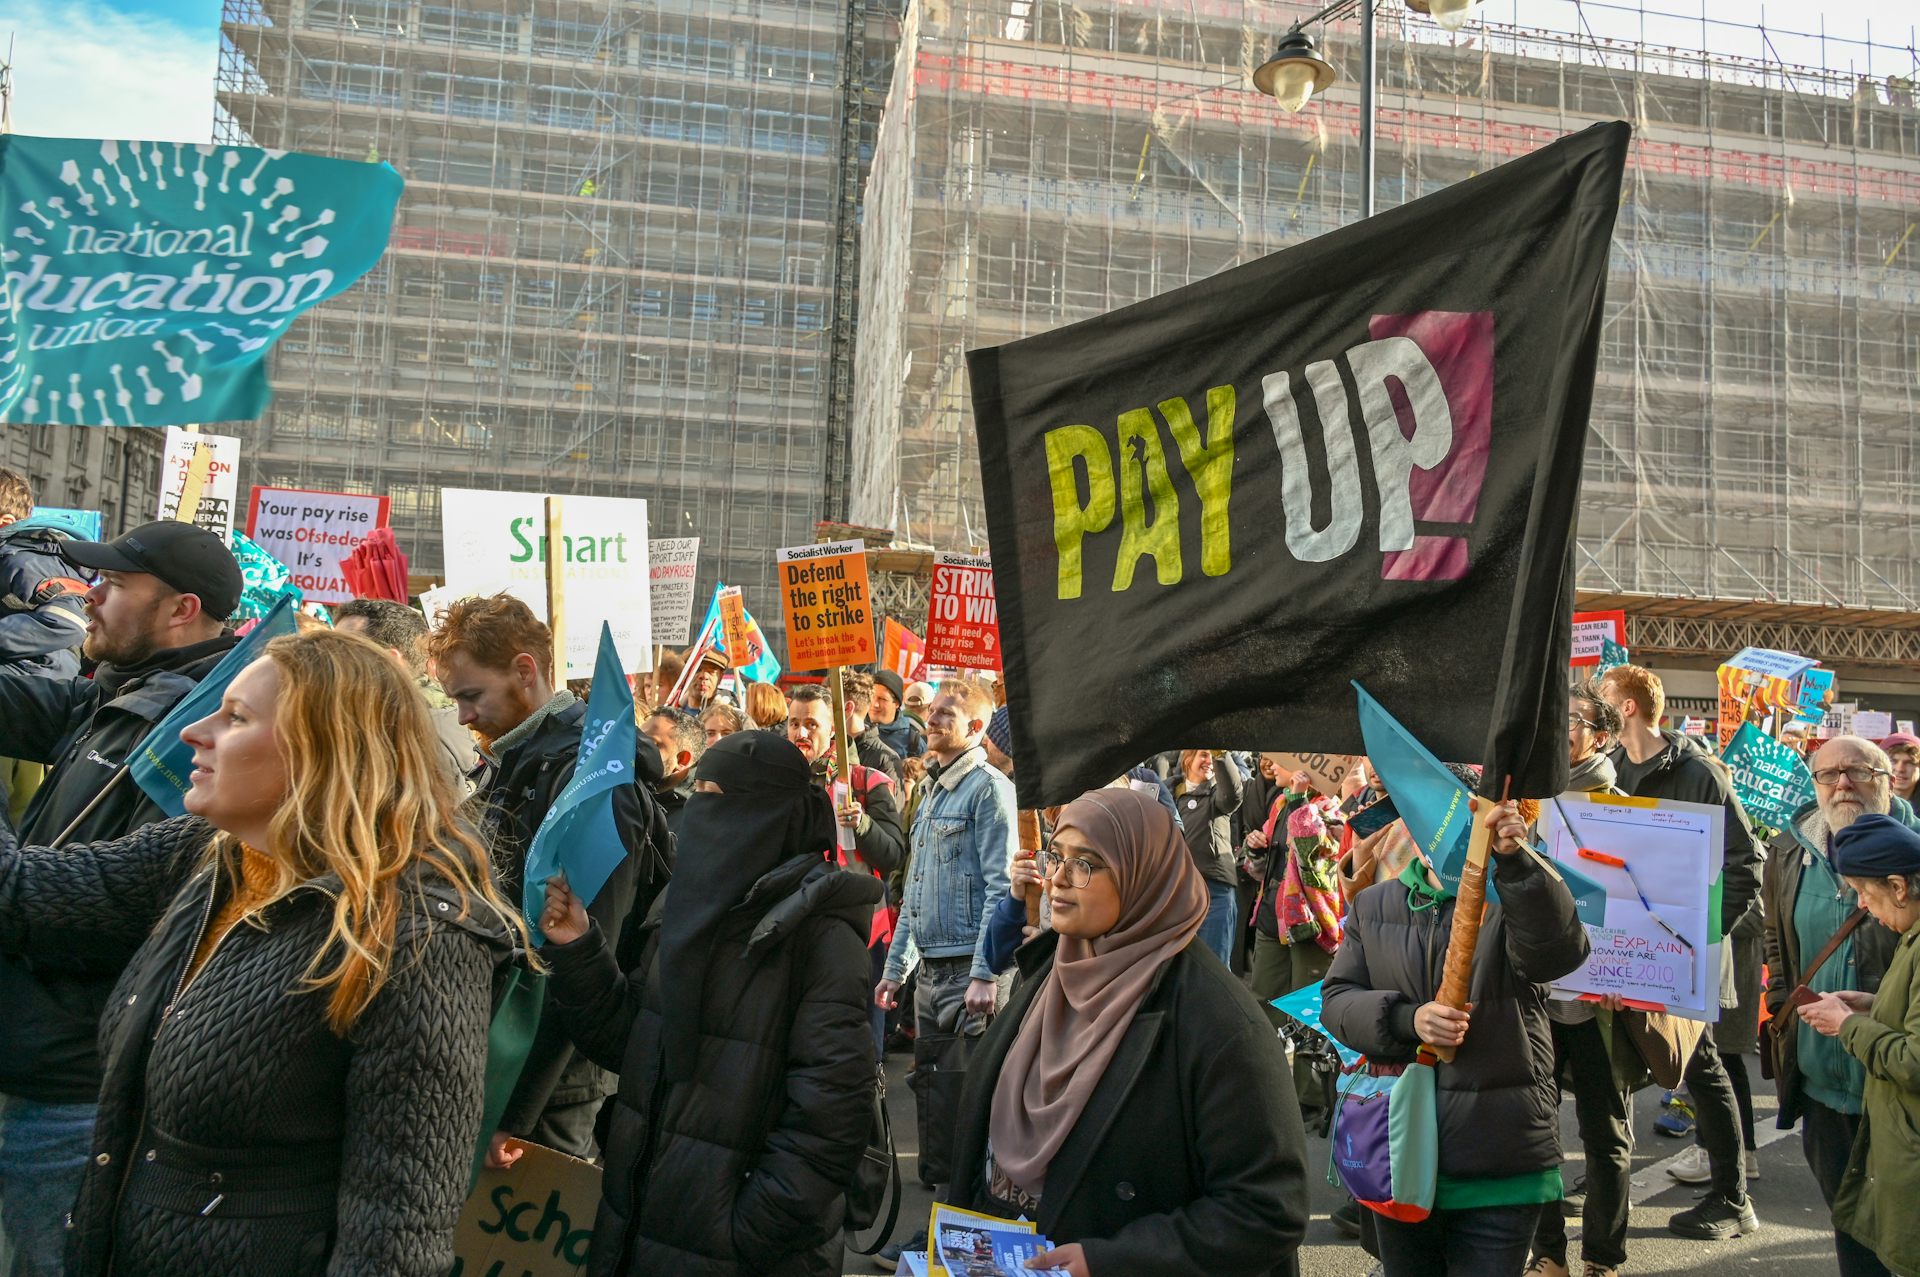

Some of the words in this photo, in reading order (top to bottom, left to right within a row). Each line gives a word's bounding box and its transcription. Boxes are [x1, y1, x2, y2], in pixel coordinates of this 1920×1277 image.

[62, 211, 255, 257] national
[28, 311, 167, 351] union
[1044, 384, 1236, 600] PAY
[1261, 310, 1494, 581] UP!
[197, 500, 215, 511] OR
[216, 501, 228, 512] A
[260, 500, 297, 516] Your
[302, 507, 335, 523] pay
[338, 506, 368, 522] rise
[194, 514, 227, 525] NERAL
[260, 528, 293, 540] was
[648, 541, 655, 552] E
[656, 540, 676, 553] NEED
[676, 539, 693, 551] OUR
[787, 546, 823, 560] Socialist
[823, 544, 853, 555] Worker
[297, 552, 322, 567] It's
[648, 553, 674, 565] PPORT
[673, 551, 695, 562] STAFF
[943, 555, 975, 567] Socialist
[975, 558, 992, 568] Wor
[662, 565, 675, 578] PAY
[673, 564, 695, 578] RISES
[787, 560, 845, 585] Defend
[935, 567, 995, 598] STRIK
[790, 588, 817, 608] the
[822, 582, 862, 608] right
[934, 593, 959, 621] TO
[793, 612, 811, 631] to
[816, 605, 864, 628] strike
[934, 623, 946, 634] We
[949, 625, 959, 636] all
[962, 627, 982, 638] need
[1572, 624, 1580, 632] OU
[1581, 623, 1592, 631] CAN
[795, 636, 815, 648] Let's
[817, 633, 839, 646] break
[842, 632, 854, 642] the
[933, 637, 938, 645] a
[941, 637, 956, 649] pay
[958, 637, 975, 648] rise
[1582, 634, 1600, 642] THANK
[796, 647, 836, 660] anti-union
[838, 645, 856, 655] laws
[931, 649, 957, 661] Strike
[958, 654, 994, 666] together
[1575, 646, 1600, 655] TEACHER
[1721, 699, 1741, 710] WITH
[1823, 719, 1841, 728] UT!
[1293, 753, 1345, 783] OOLS
[1753, 758, 1810, 788] national
[1728, 763, 1812, 807] educatio
[1603, 806, 1622, 815] Figure
[1748, 793, 1784, 812] union
[1590, 933, 1614, 942] AND
[1613, 935, 1683, 955] EXPLAIN
[1589, 947, 1616, 956] HOW
[1617, 949, 1634, 957] WE
[1636, 952, 1656, 960] ARE
[1588, 964, 1633, 978] SINCE
[1635, 964, 1674, 983] 2010
[477, 1185, 593, 1266] Scho
